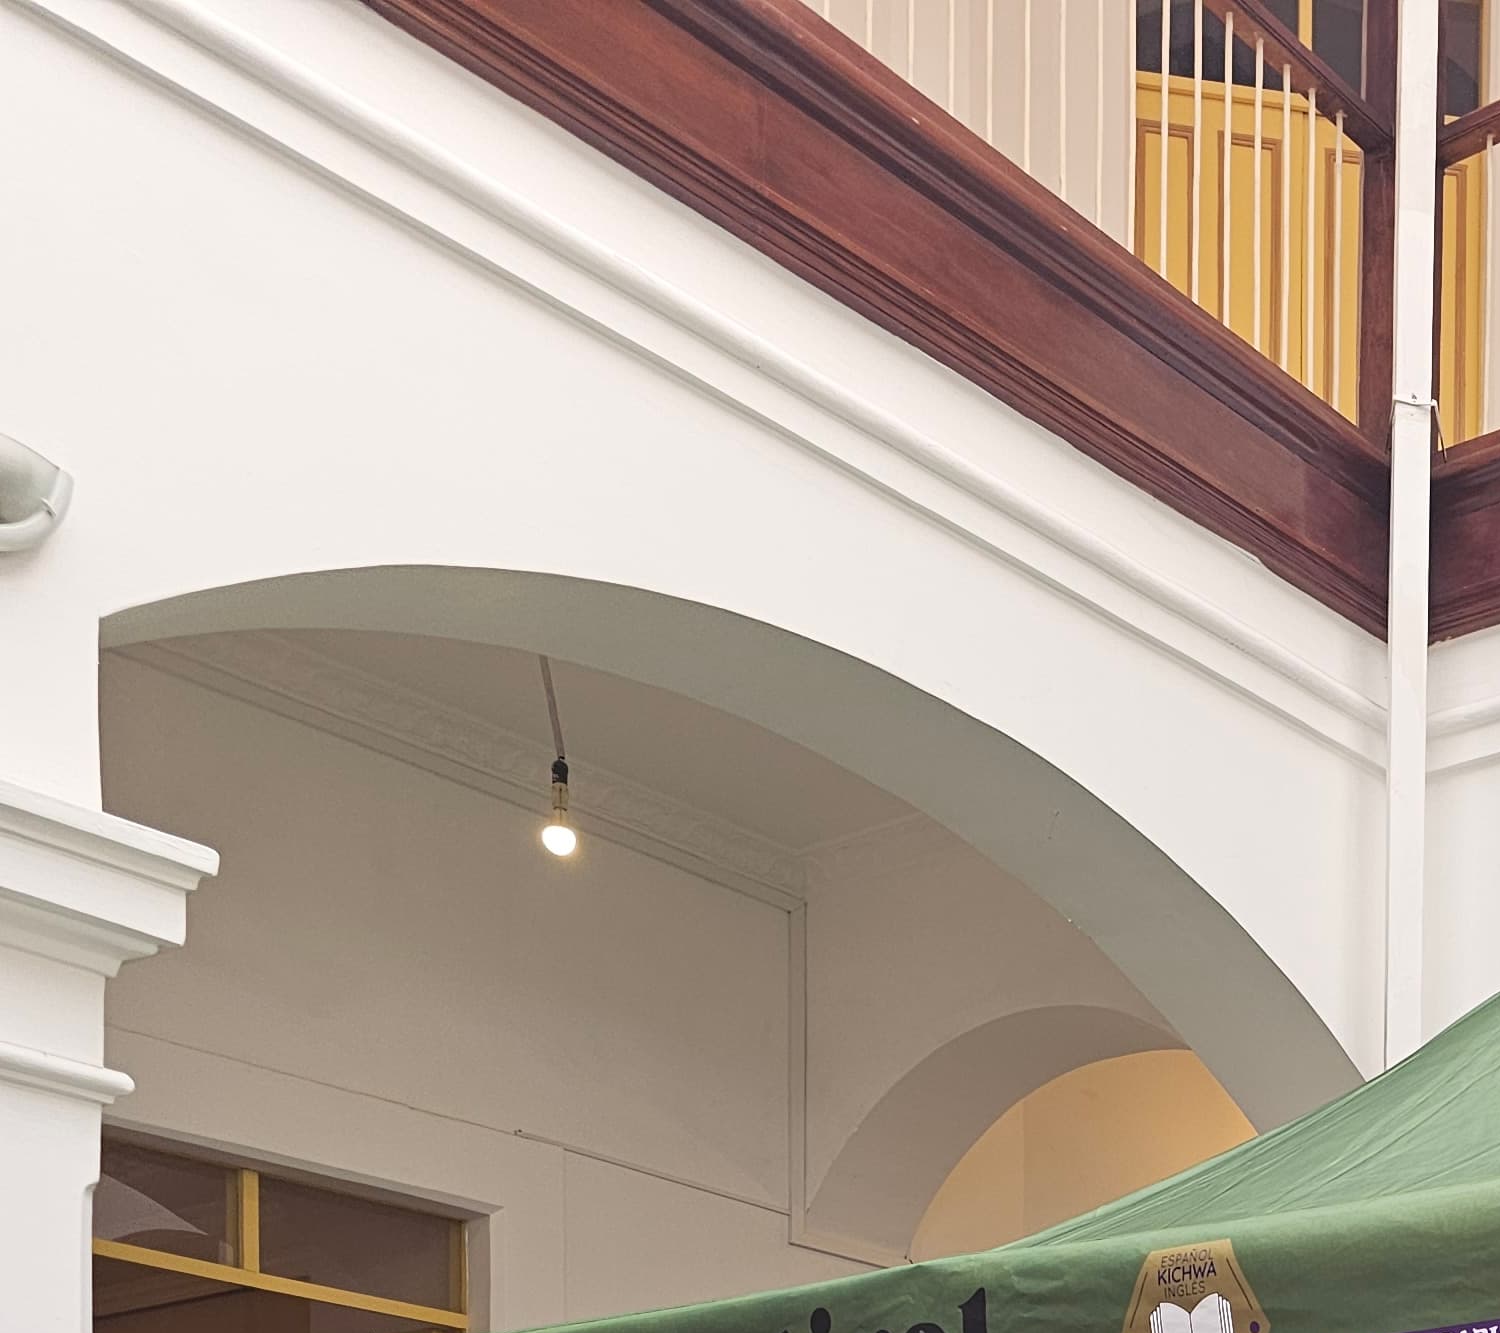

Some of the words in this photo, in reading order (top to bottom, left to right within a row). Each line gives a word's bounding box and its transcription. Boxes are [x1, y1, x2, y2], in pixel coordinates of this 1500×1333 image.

[1161, 1248, 1214, 1268] ESPAÑOL
[1157, 1261, 1217, 1286] KICHWA
[1164, 1280, 1206, 1299] INGLÉS
